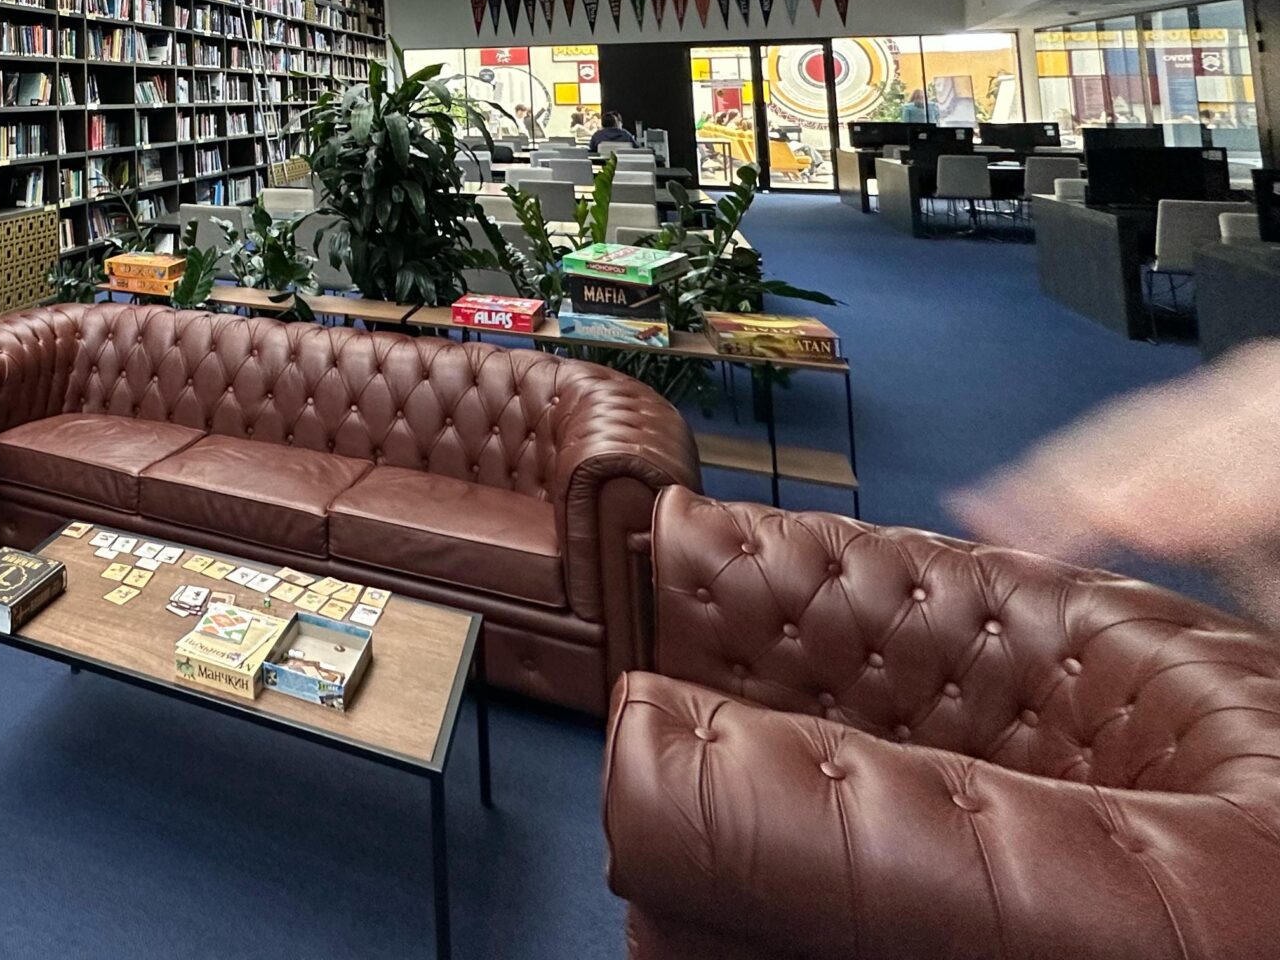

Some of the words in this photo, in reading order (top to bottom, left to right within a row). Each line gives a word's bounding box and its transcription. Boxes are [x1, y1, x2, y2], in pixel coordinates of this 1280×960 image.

[589, 263, 626, 274] MONOPOLY
[584, 285, 627, 305] MAFIA
[474, 311, 513, 329] ALIAS
[197, 664, 249, 690] Манчкин
